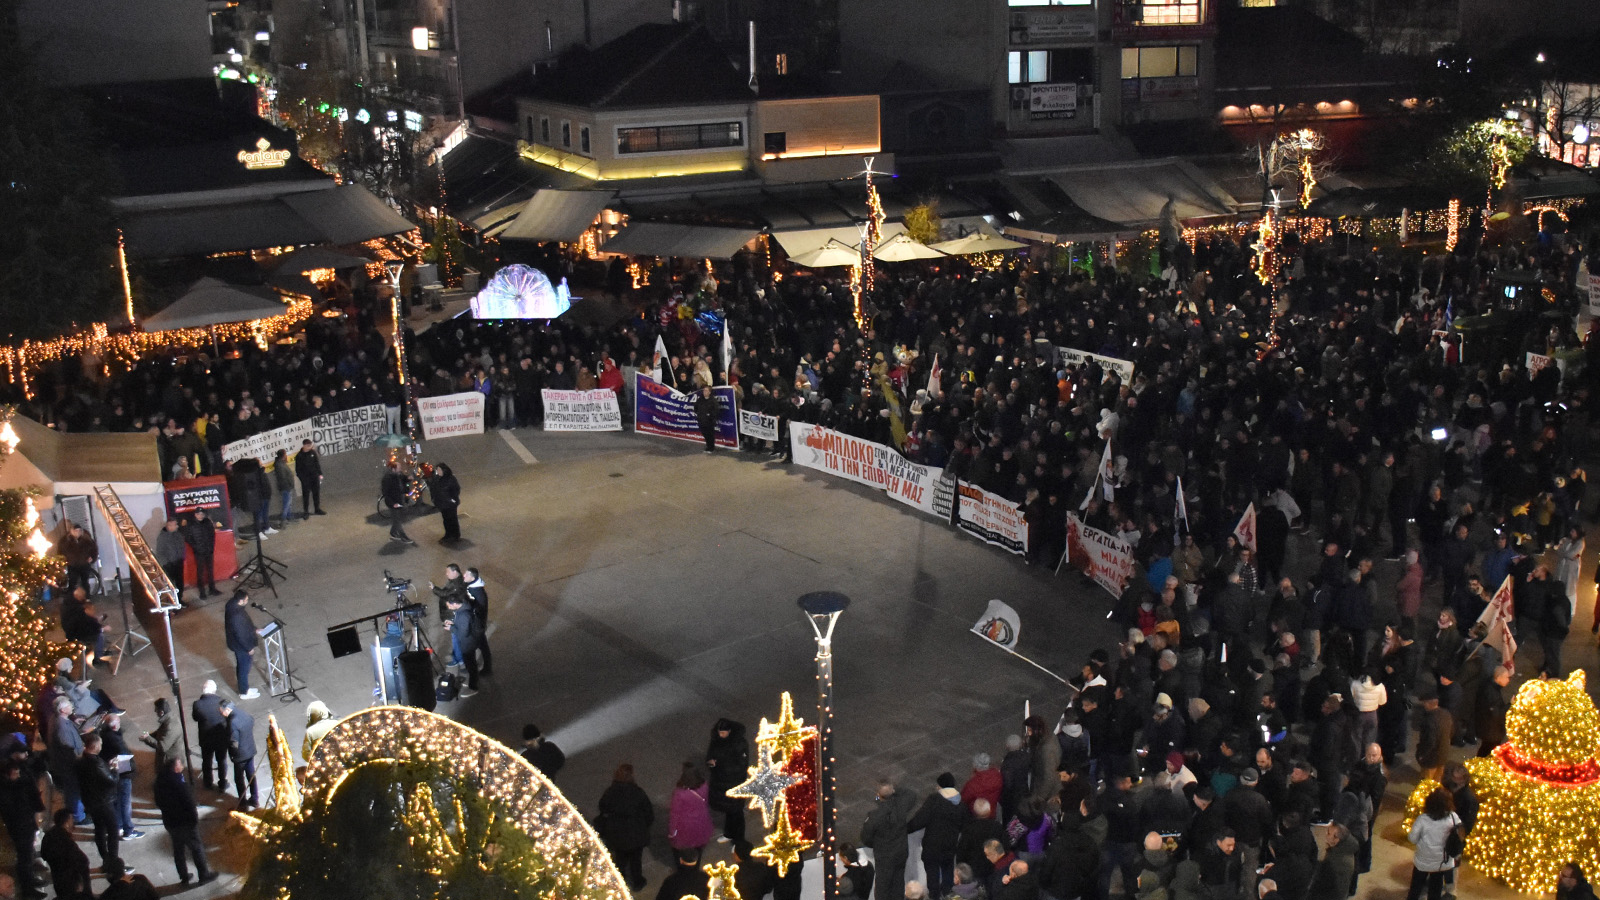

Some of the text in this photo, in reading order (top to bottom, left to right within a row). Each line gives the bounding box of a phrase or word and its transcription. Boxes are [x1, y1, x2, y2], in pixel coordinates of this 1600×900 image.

[238, 149, 291, 163] fontaine
[825, 432, 874, 466] ΜΠΛΟΚΟ
[825, 452, 839, 471] ΓΙΑ
[841, 457, 860, 478] ΤΗΝ
[862, 463, 900, 494] ΕΠΙΒΙΣΗ
[902, 480, 925, 505] ΜΑΣ
[878, 458, 921, 485] & ΝΕΑ ΚΑΠ
[174, 488, 220, 500] ΑΣΥΓΚΡΙΤΑ
[174, 495, 221, 507] ΤΡΑΓΑΝΑ
[1101, 550, 1118, 566] ΜΙΑ
